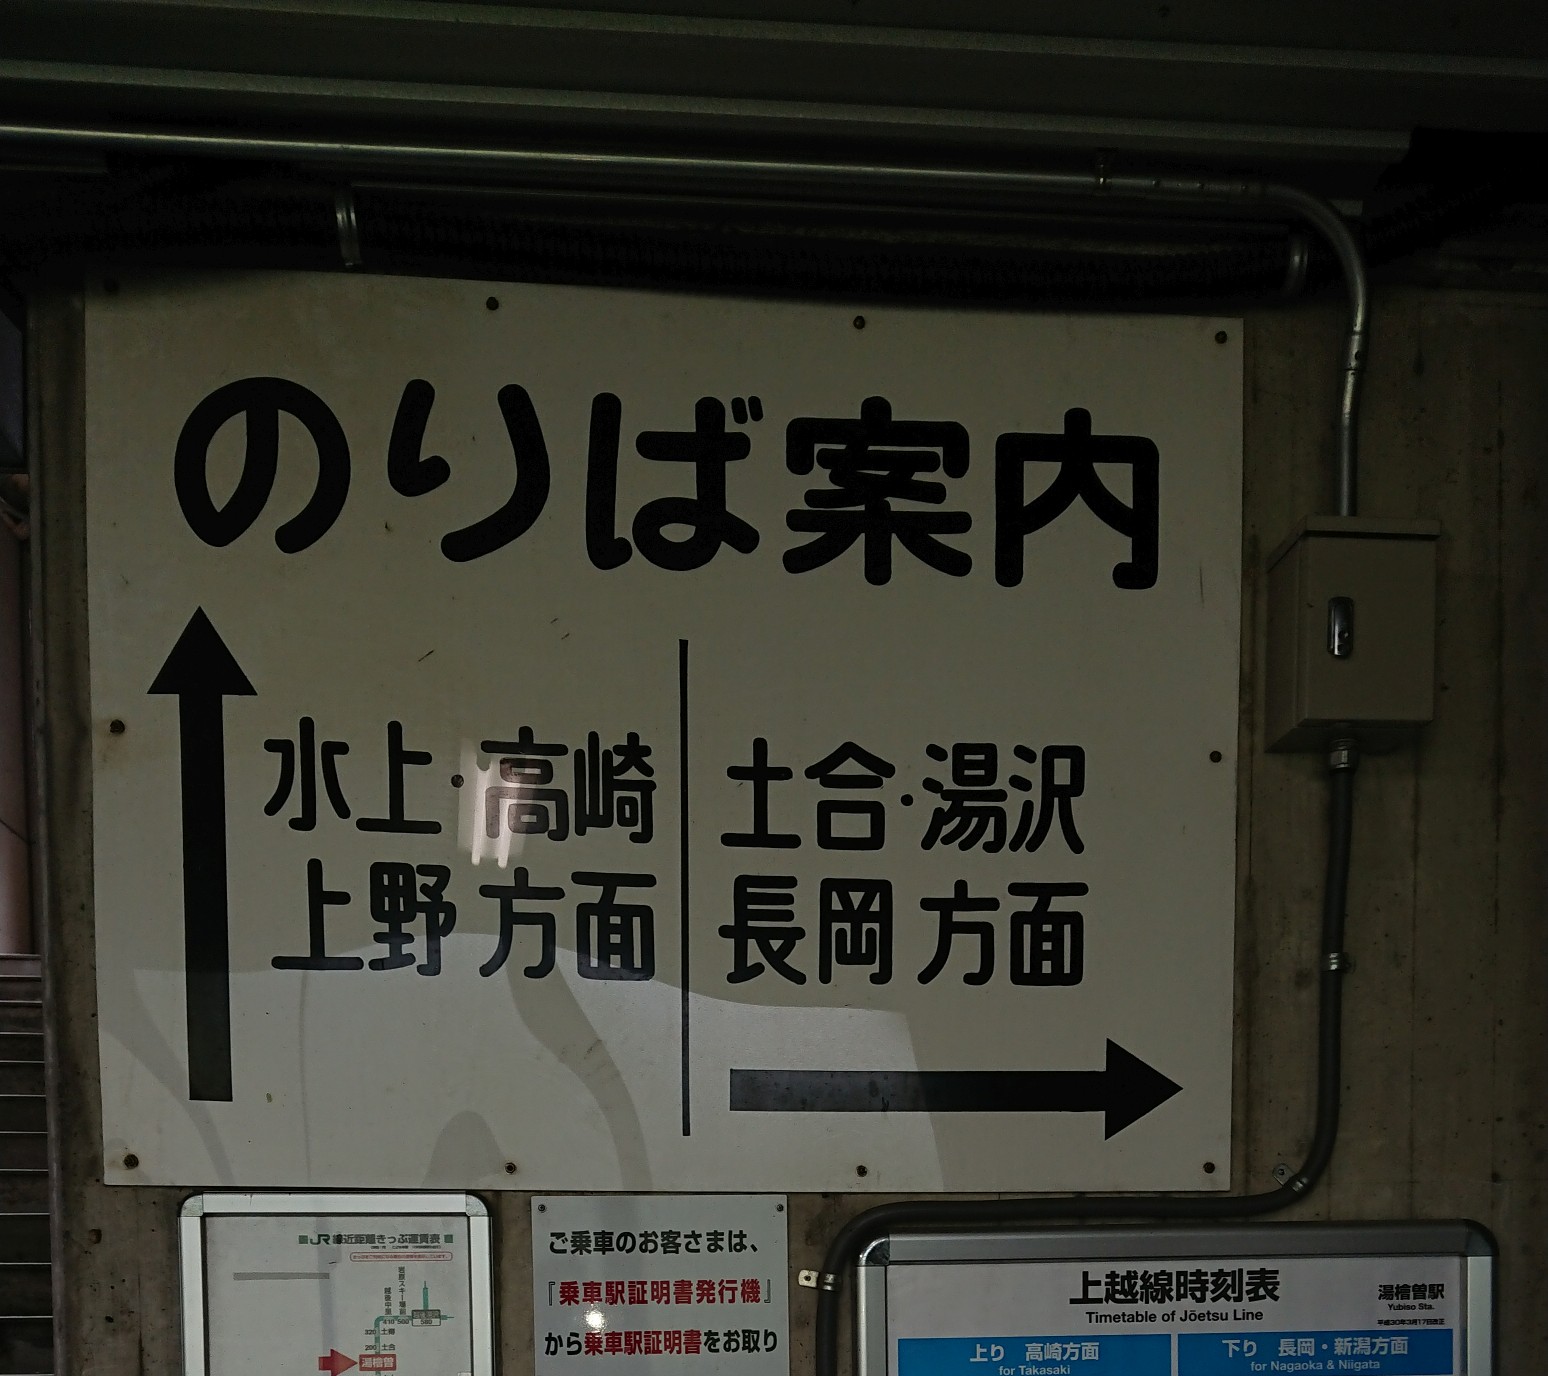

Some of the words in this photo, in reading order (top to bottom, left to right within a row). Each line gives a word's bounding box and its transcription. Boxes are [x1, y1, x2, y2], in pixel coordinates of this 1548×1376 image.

[174, 376, 1160, 590] のりば案内
[263, 716, 657, 844] 水上・高崎
[720, 737, 1087, 857] 土合・湯沢
[270, 858, 657, 980] 上野方面
[718, 875, 1089, 987] 長岡方面
[549, 1230, 759, 1255] ご乗車のお客さまは、
[548, 1279, 772, 1306] 『乗車駅証明書発行機』
[1069, 1268, 1280, 1305] 上越線時刻表
[1085, 1311, 1157, 1323] Timetable
[1161, 1310, 1176, 1322] of
[1179, 1310, 1229, 1322] Jōetsu
[1233, 1309, 1264, 1321] Line
[1388, 1303, 1416, 1311] Yubiso
[544, 1330, 778, 1356] から乗車駅証明書をお取り
[970, 1343, 1005, 1362] 上り
[1025, 1341, 1100, 1361] 高崎方面
[1222, 1339, 1257, 1358] 下り
[1278, 1336, 1409, 1356] 長岡・新潟方面
[999, 1366, 1015, 1376] for
[1018, 1365, 1071, 1375] Takasaki
[1250, 1361, 1267, 1371] for
[1271, 1360, 1323, 1373] Nagaoka
[1326, 1360, 1335, 1369] &
[1338, 1360, 1381, 1372] Niigata
